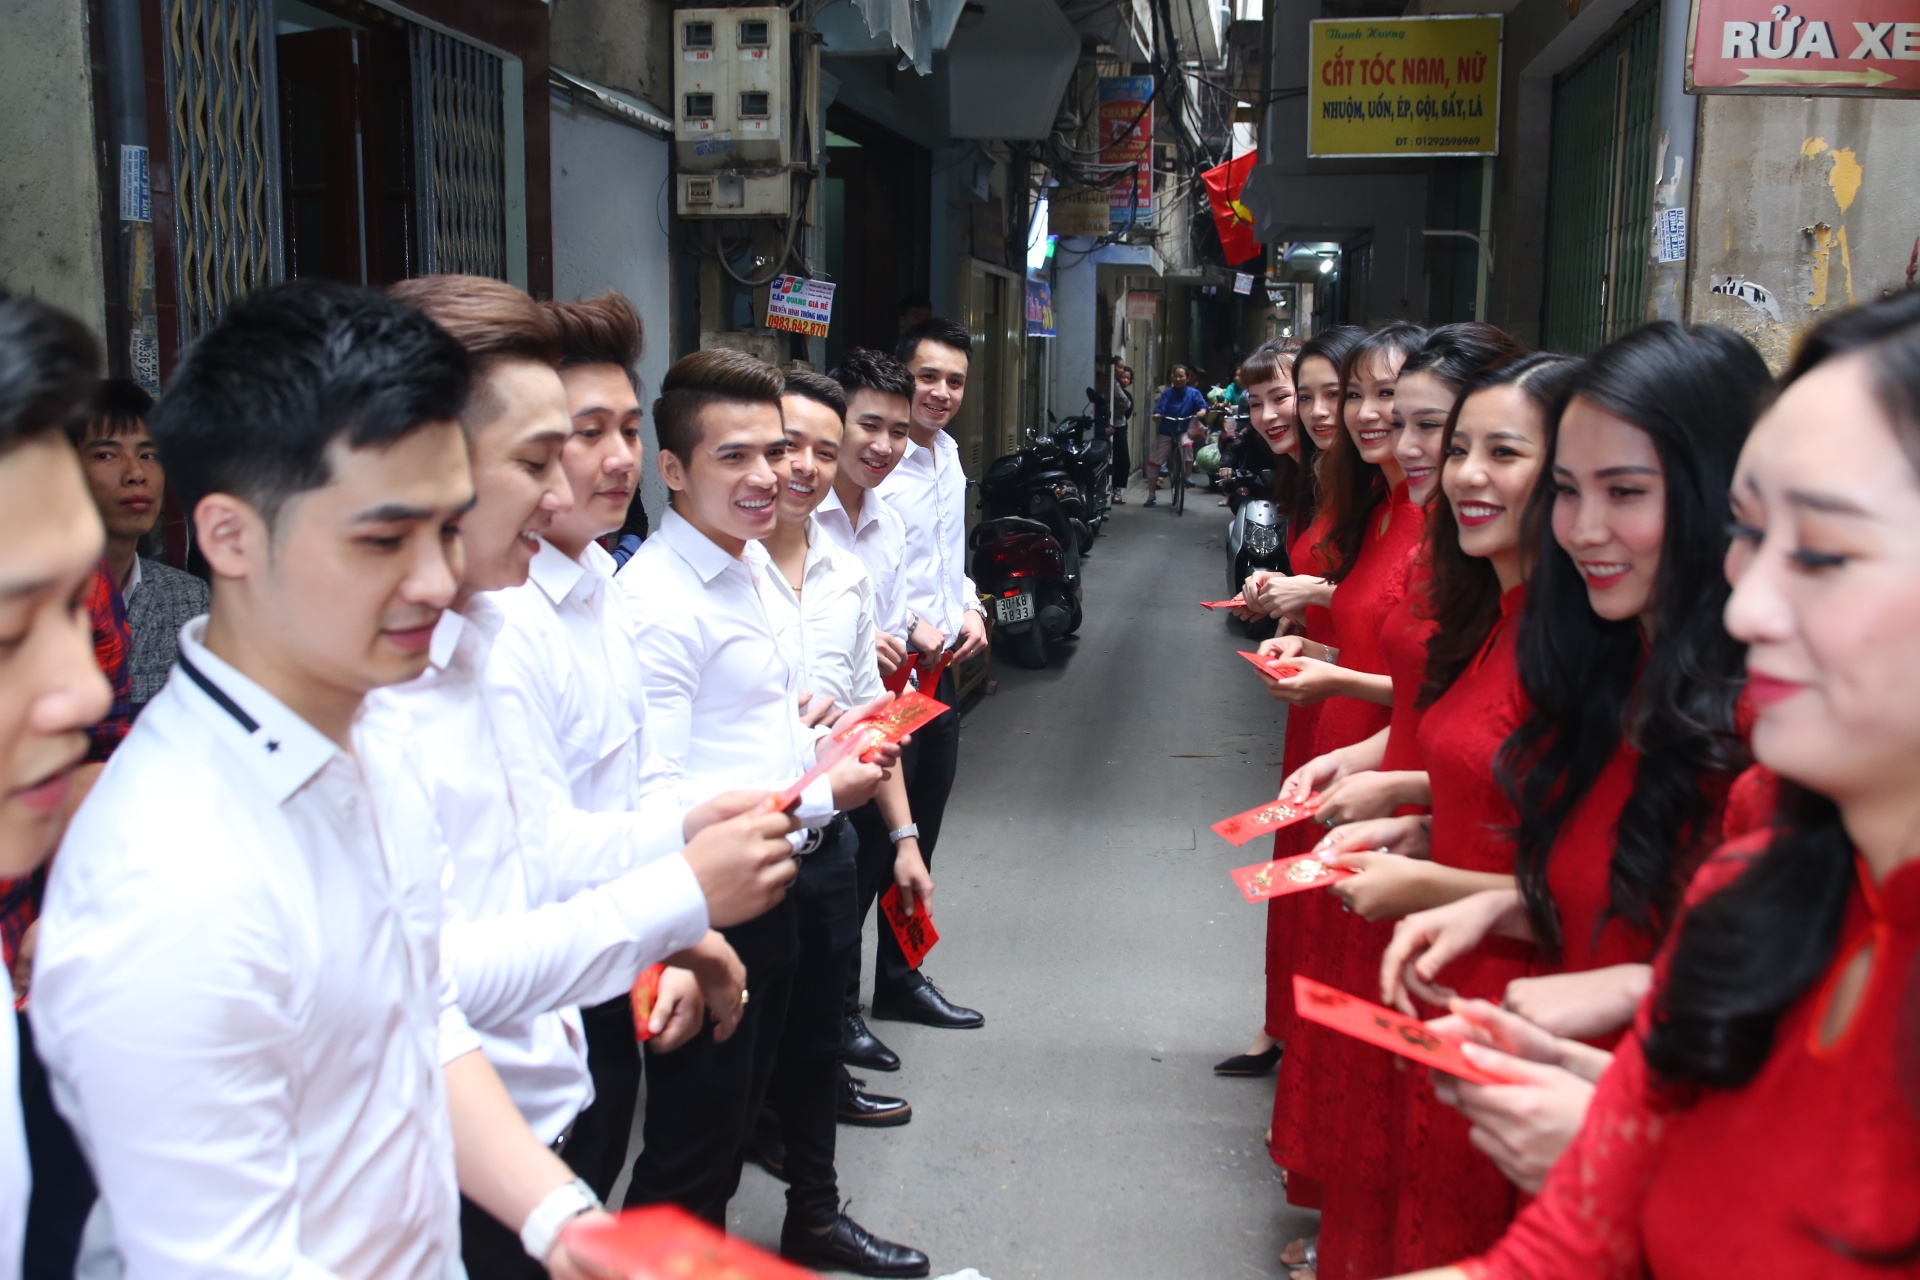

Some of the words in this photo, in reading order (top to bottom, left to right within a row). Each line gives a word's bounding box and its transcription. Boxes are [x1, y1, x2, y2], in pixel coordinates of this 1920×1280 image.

[1327, 28, 1362, 40] Thanh
[1721, 5, 1838, 59] RỬA
[1848, 22, 1920, 61] XE
[1322, 46, 1355, 86] CẮT
[1360, 52, 1396, 86] TÓC
[1402, 57, 1450, 90] NAM,
[1457, 51, 1488, 84] NỮ
[1322, 96, 1365, 124] NHUỘM,
[1368, 93, 1394, 122] UỐN,
[1416, 136, 1481, 147] 01292596969
[1676, 210, 1684, 223] 770
[1677, 225, 1685, 238] 278
[773, 278, 803, 293] FPT
[786, 296, 807, 306] QUANG
[767, 314, 827, 338] 0983.642.870
[1002, 607, 1029, 622] 3833
